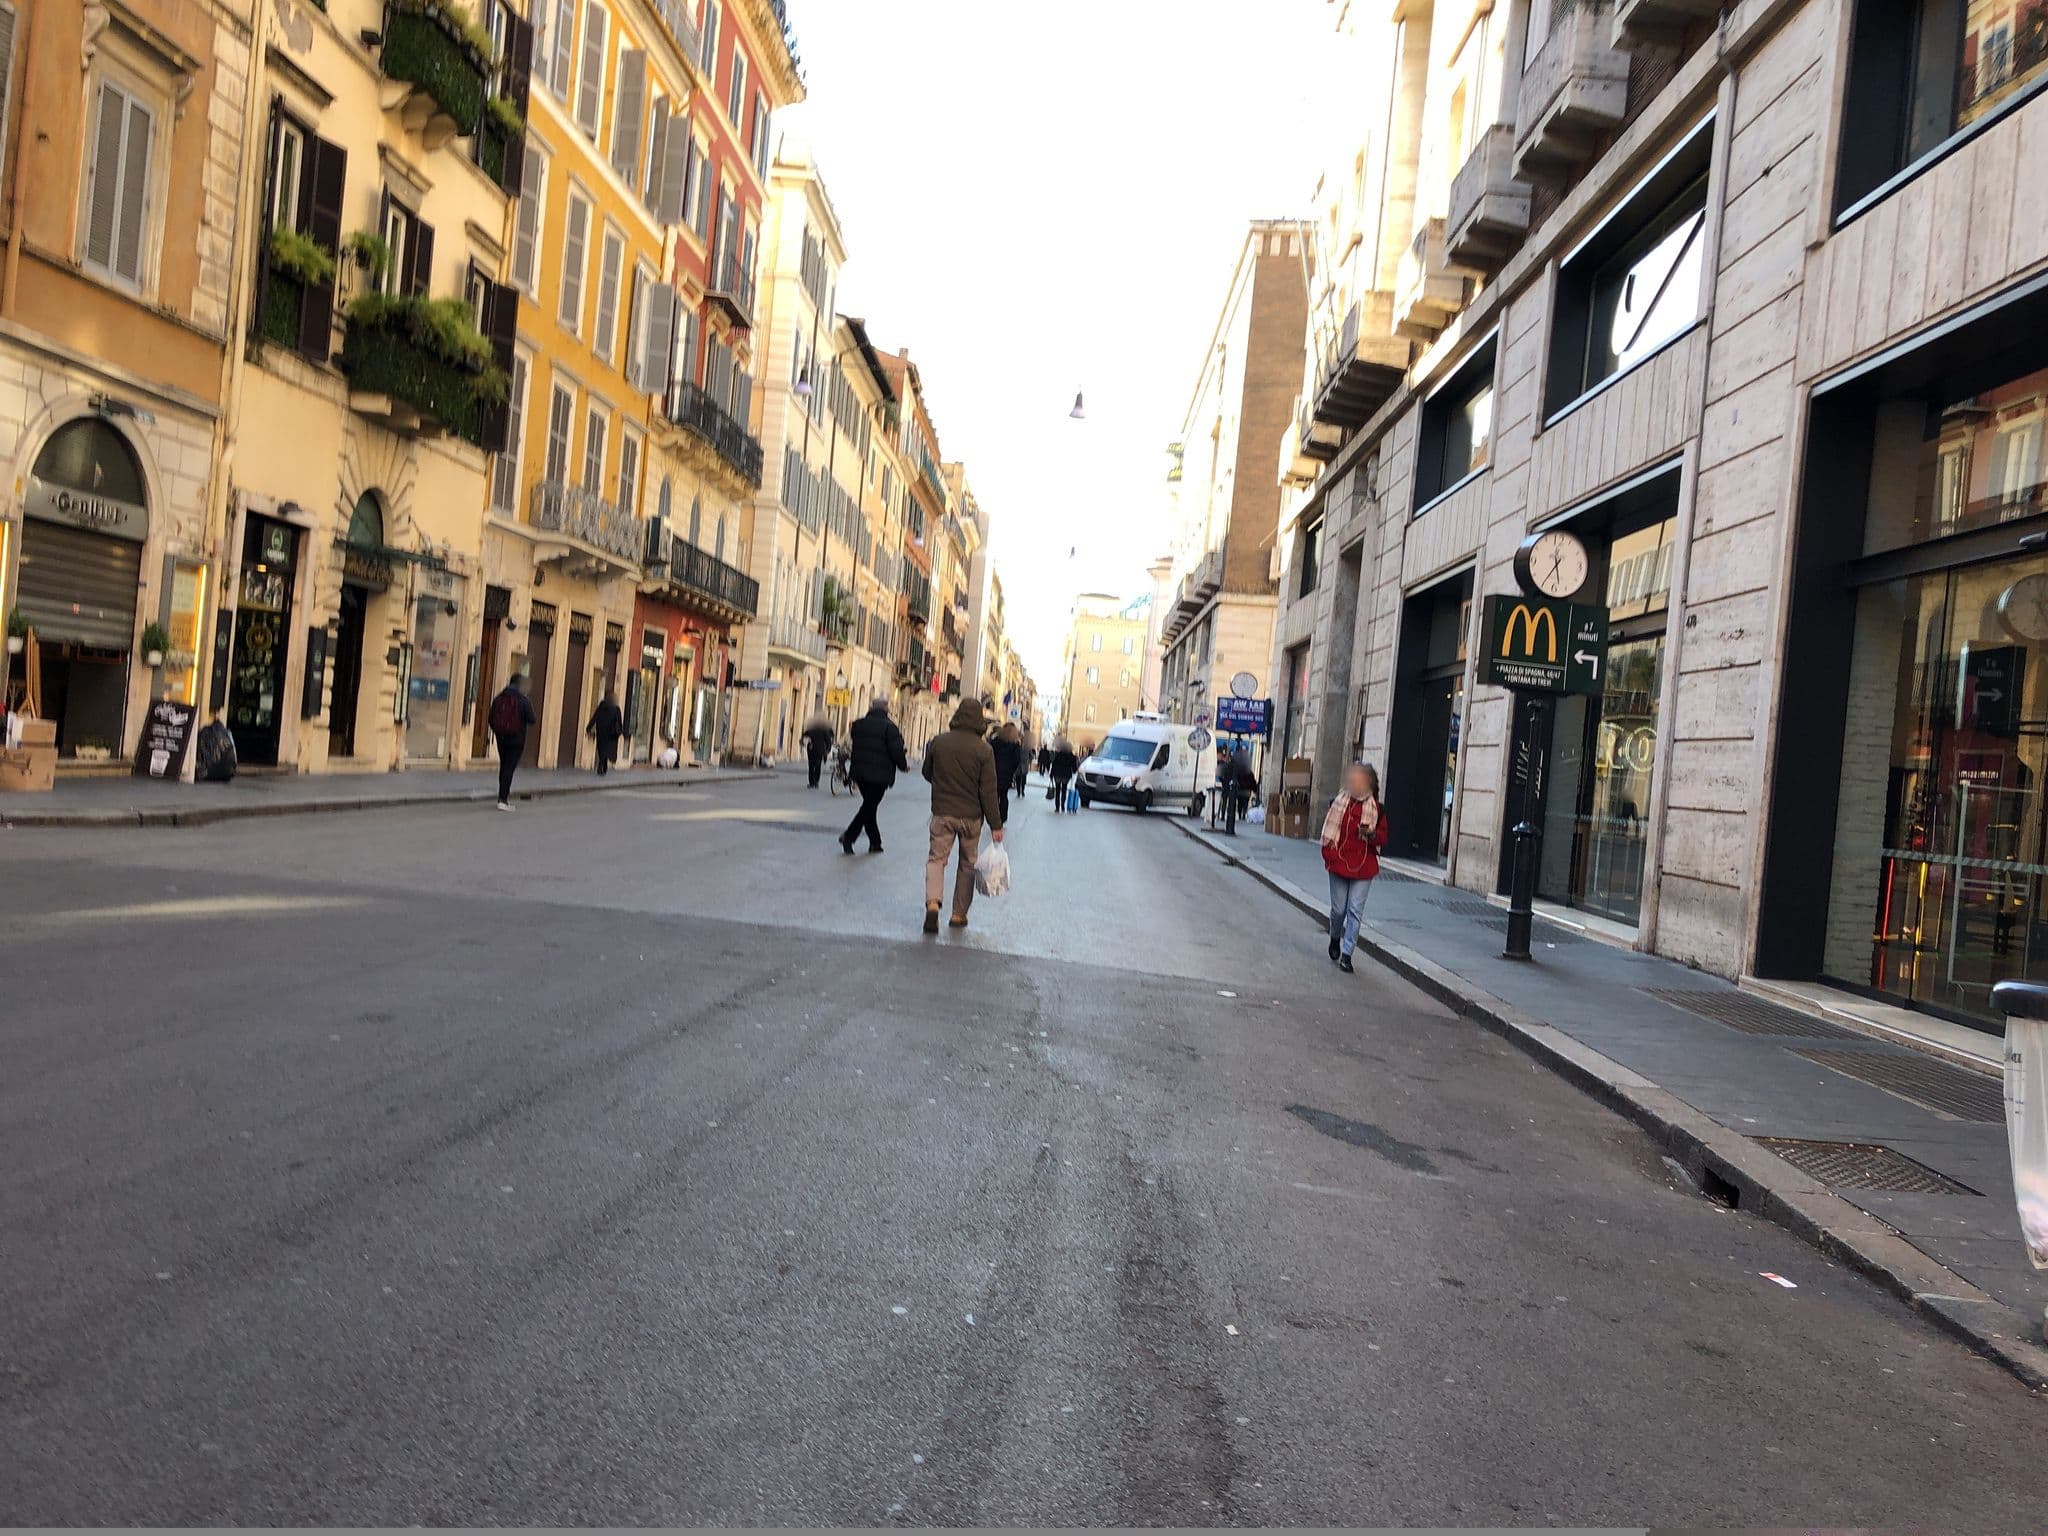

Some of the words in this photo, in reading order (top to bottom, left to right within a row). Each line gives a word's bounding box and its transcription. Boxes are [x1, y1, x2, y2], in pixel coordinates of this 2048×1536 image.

[1577, 631, 1599, 643] minuti
[1500, 663, 1518, 675] PIAZZA
[1518, 666, 1525, 676] DI
[1507, 674, 1531, 685] FONTANA
[1531, 677, 1537, 686] DI
[1538, 678, 1552, 687] TREVI
